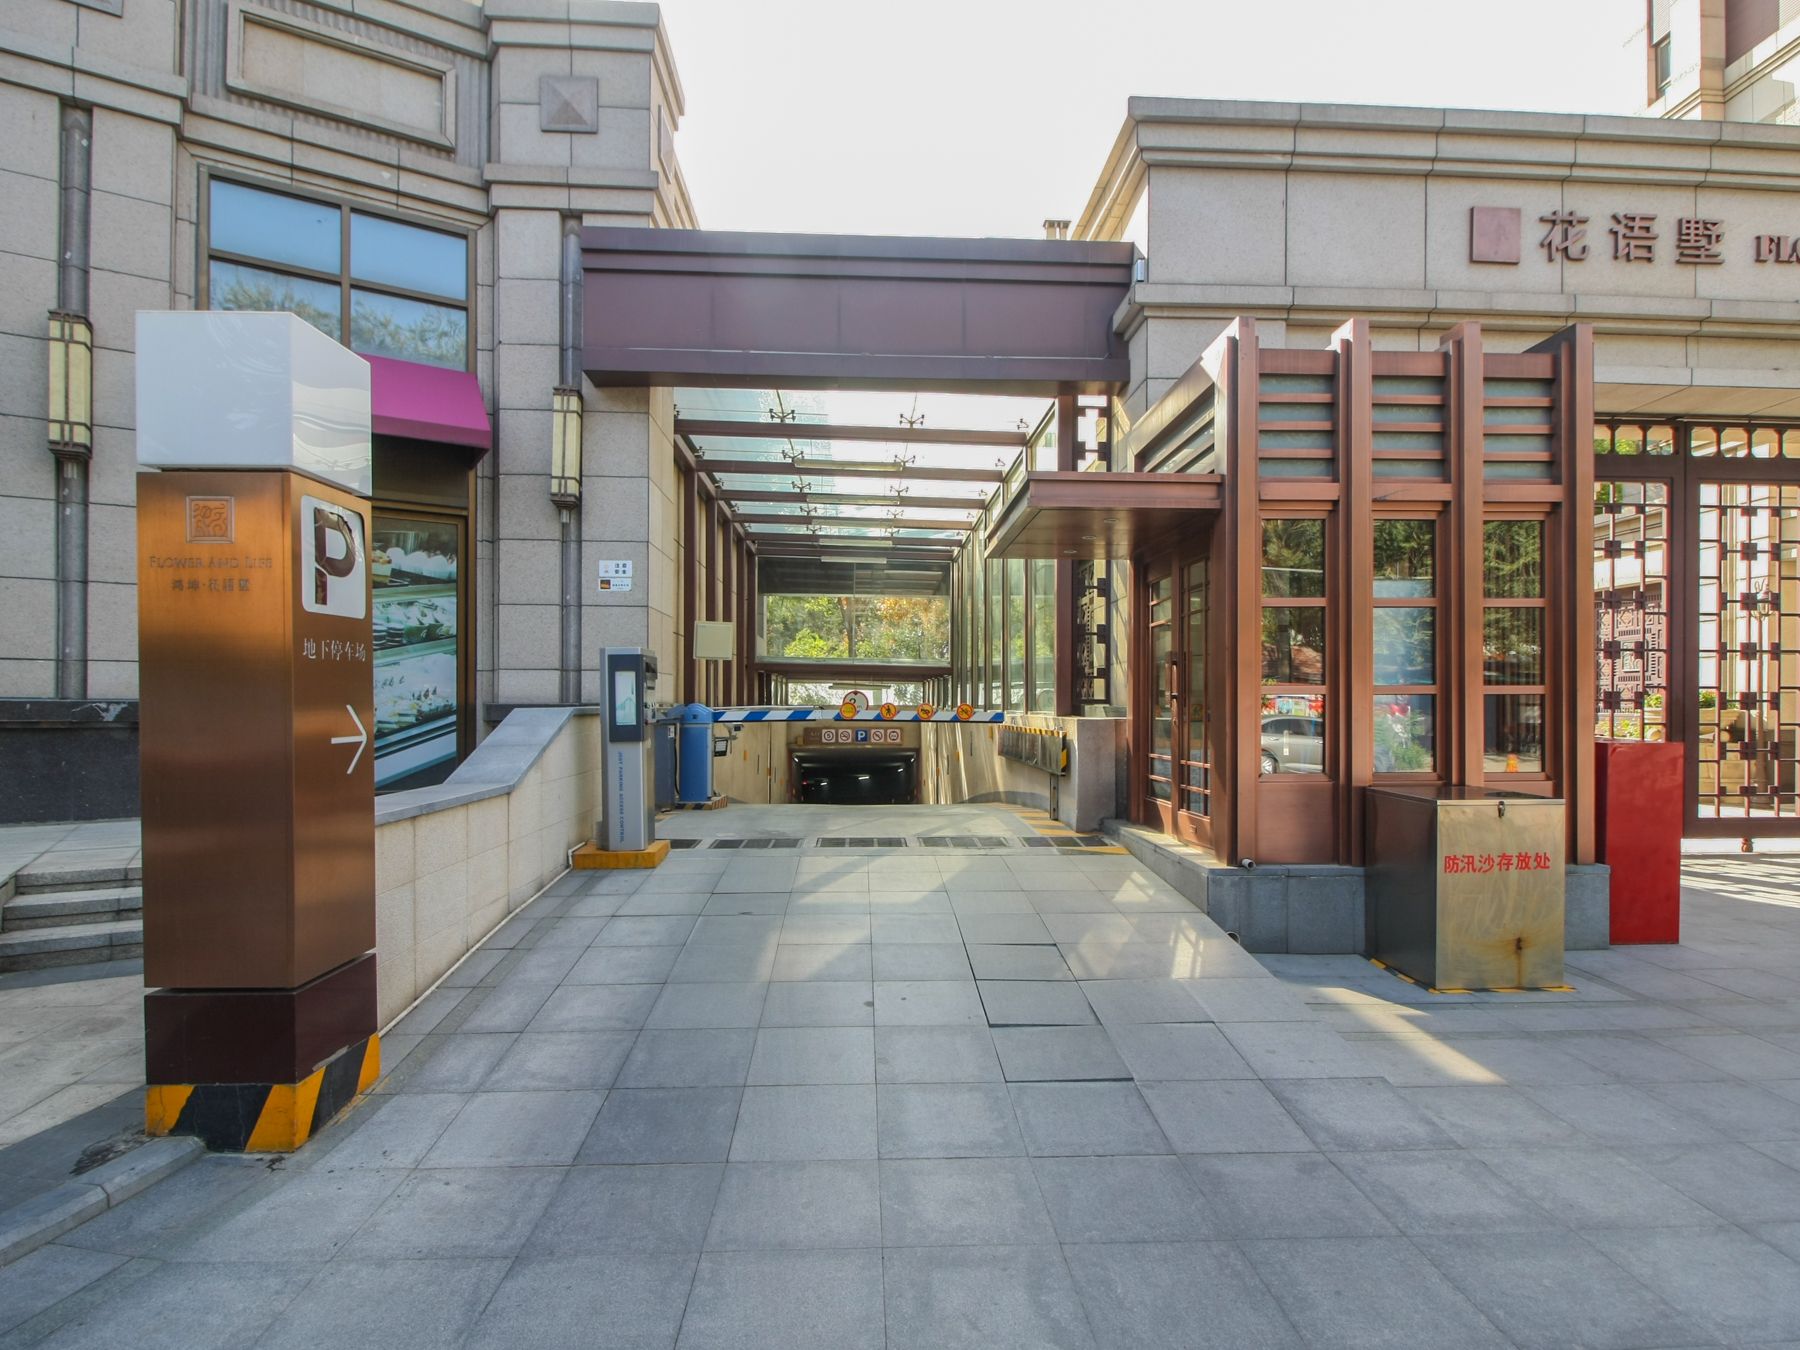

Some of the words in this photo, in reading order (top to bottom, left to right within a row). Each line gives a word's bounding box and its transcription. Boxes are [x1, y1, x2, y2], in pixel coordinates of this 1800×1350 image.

[1538, 209, 1726, 265] 花语墅
[149, 556, 204, 569] FLOWER
[208, 556, 241, 569] AND
[314, 506, 356, 606] P
[303, 638, 367, 662] 地下停车场
[858, 731, 866, 741] P
[1444, 852, 1551, 873] 防汛沙存放处
